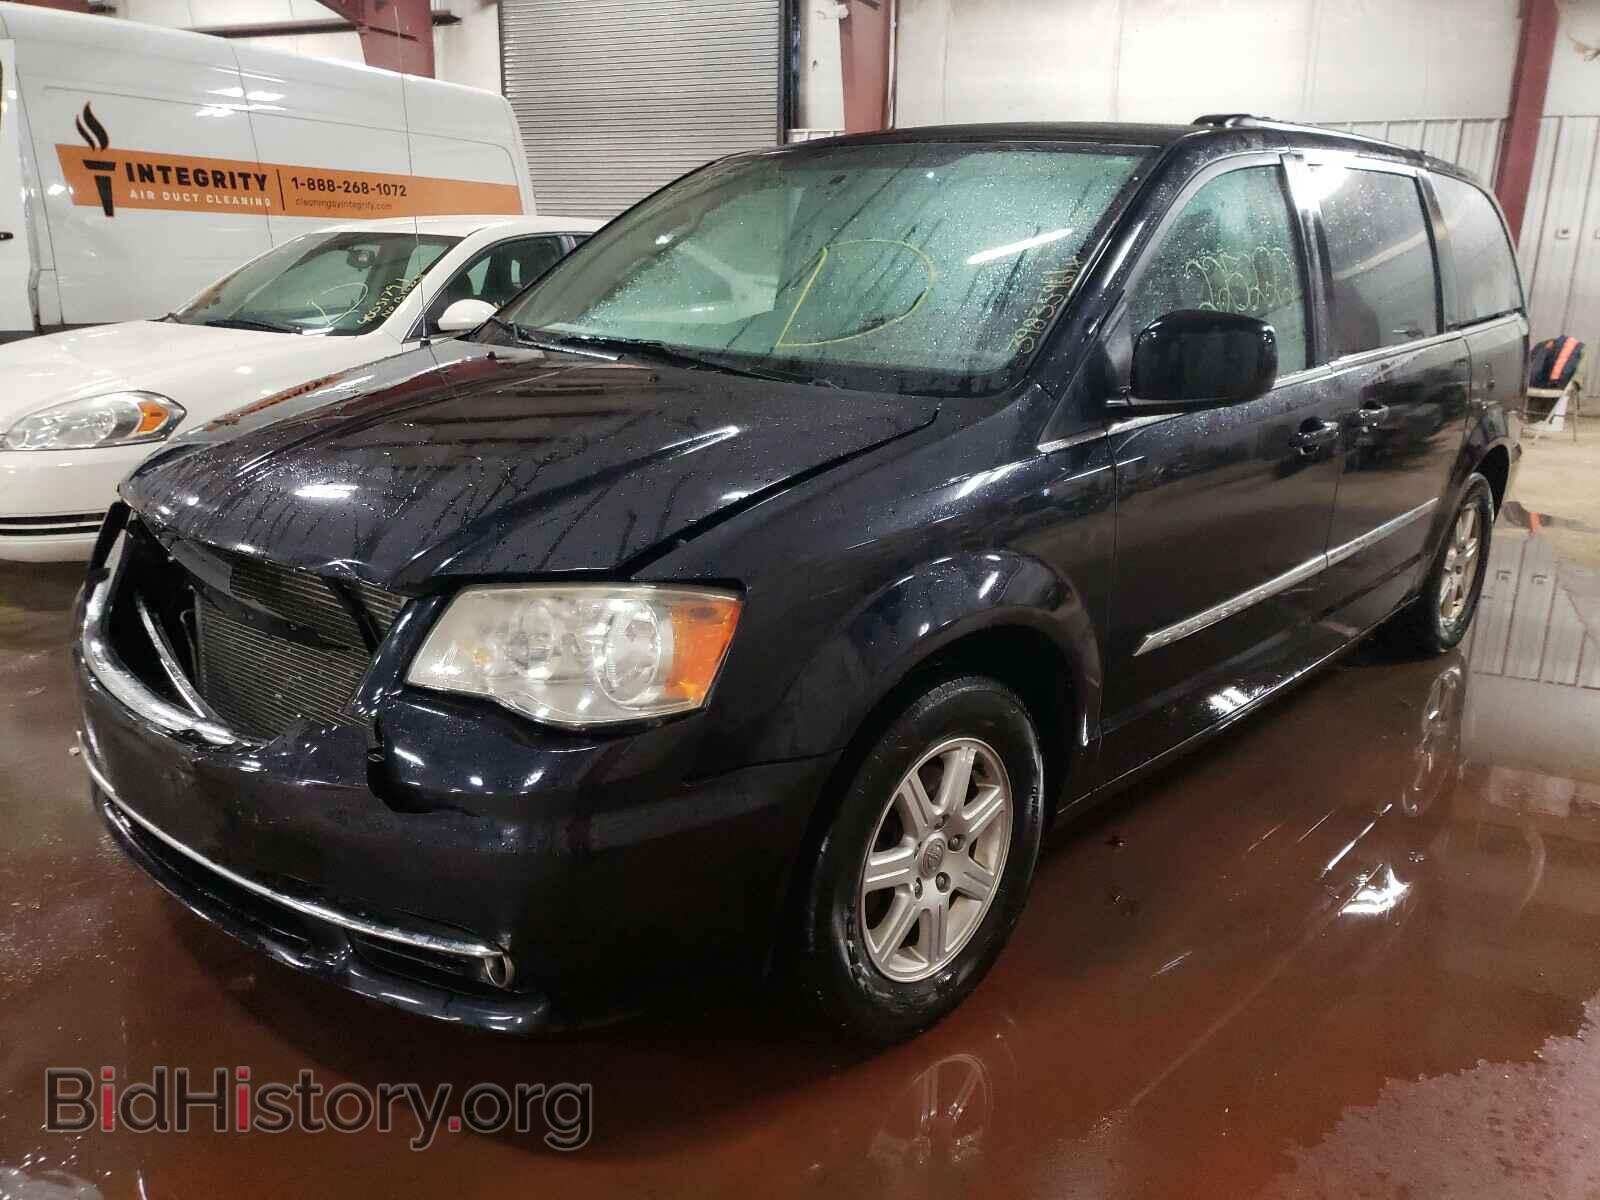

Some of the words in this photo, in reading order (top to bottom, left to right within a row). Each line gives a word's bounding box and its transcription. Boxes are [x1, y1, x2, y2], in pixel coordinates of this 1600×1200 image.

[125, 162, 267, 191] INTEGRITY
[291, 177, 407, 197] 1-888-268-1072
[129, 190, 156, 200] AIR
[162, 191, 200, 203] DUCT
[206, 195, 271, 207] CLEANING
